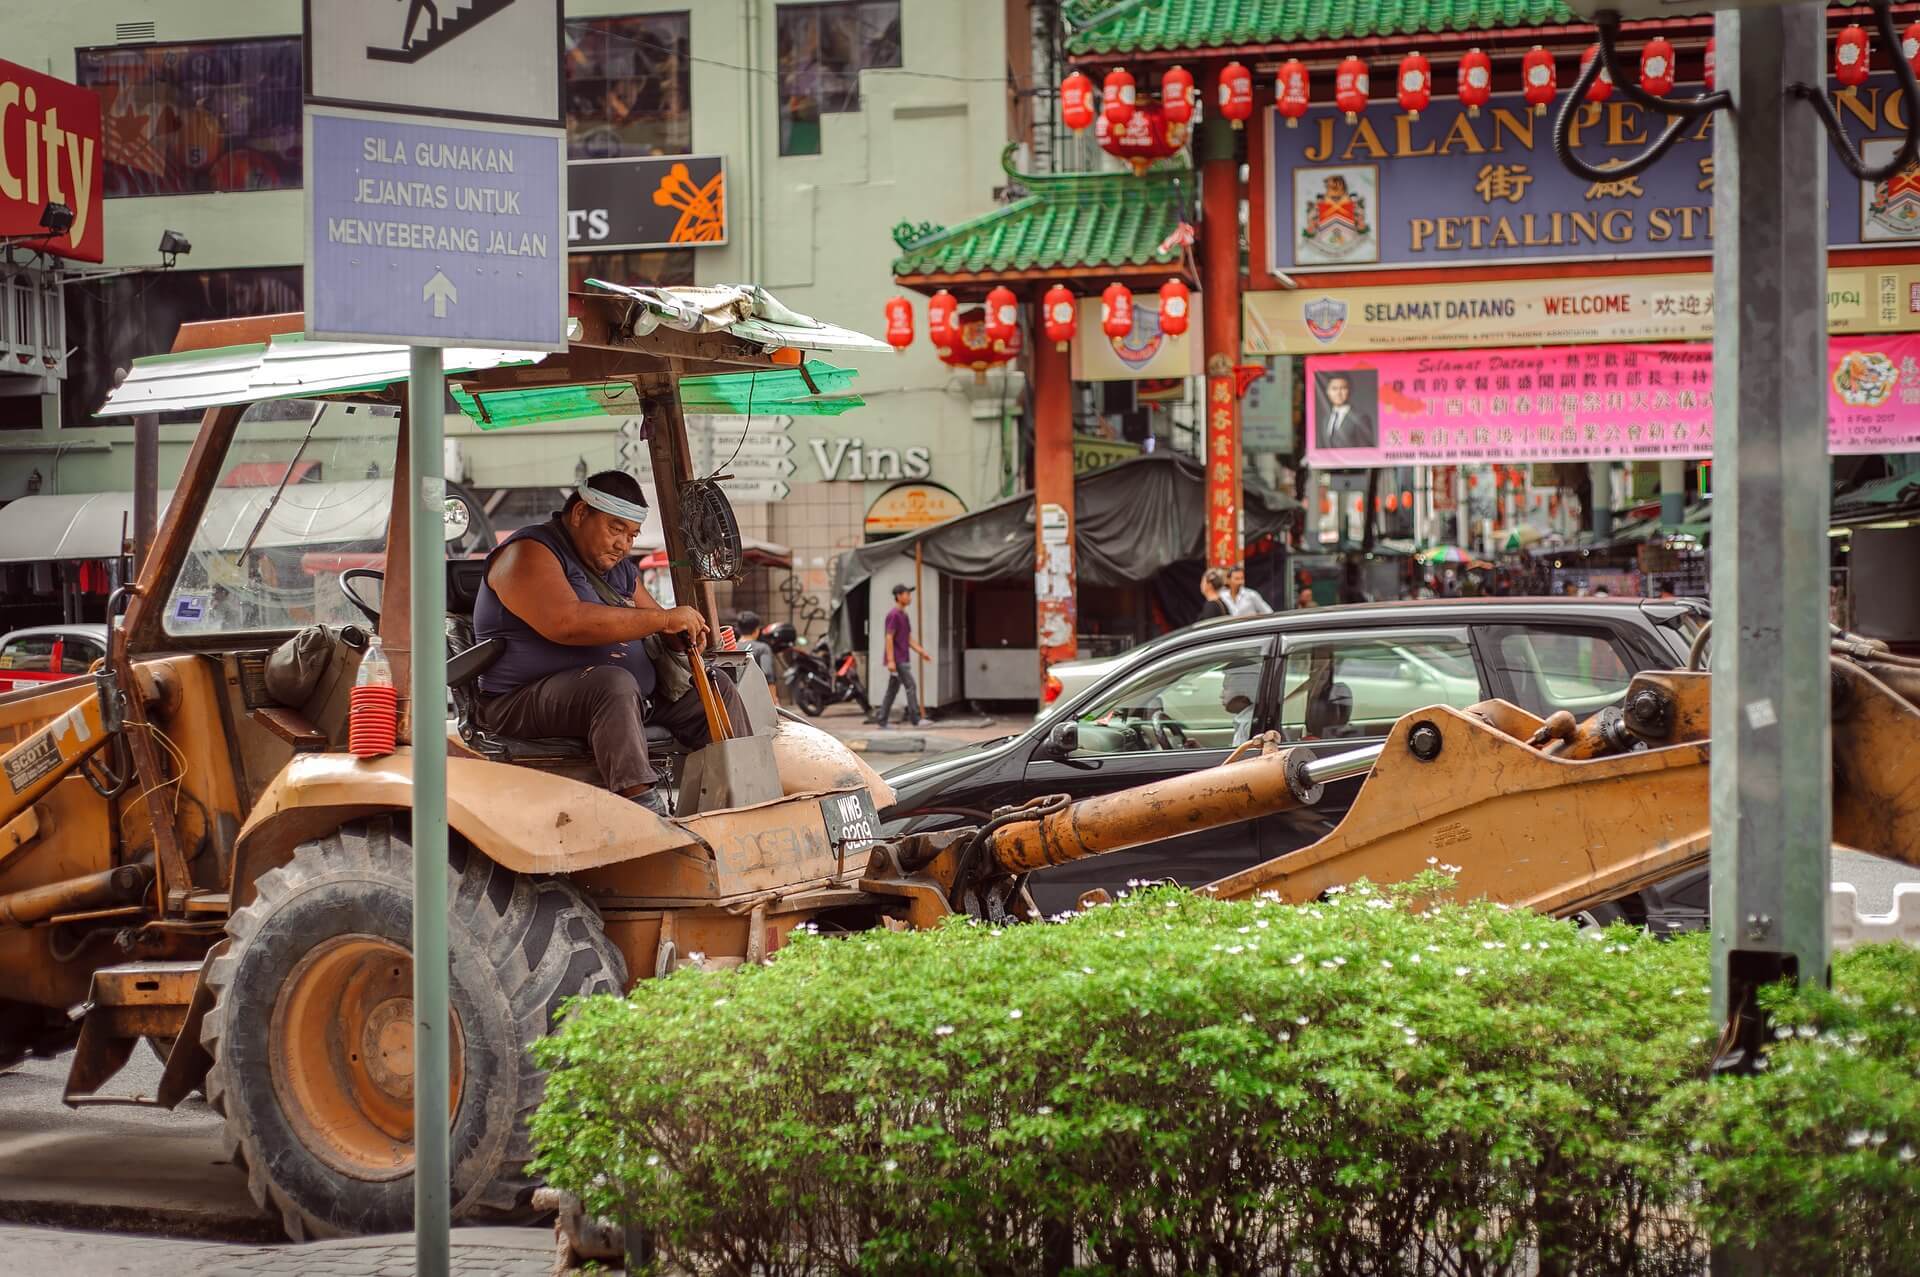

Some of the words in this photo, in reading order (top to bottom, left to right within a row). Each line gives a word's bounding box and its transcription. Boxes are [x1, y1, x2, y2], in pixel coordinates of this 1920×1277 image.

[1303, 107, 1535, 161] JALAN
[0, 81, 94, 248] City
[363, 136, 408, 166] SILA
[415, 142, 514, 173] GUNAKAN
[354, 178, 448, 210] JEJANTAS
[455, 186, 521, 216] UNTUK
[328, 217, 481, 253] MENYEBERANG
[486, 229, 548, 258] JALAN
[1410, 207, 1633, 252] PETALING
[1365, 301, 1442, 323] SELAMAT
[1446, 298, 1515, 320] DATANG
[1544, 294, 1631, 316] WELCOME
[1417, 357, 1481, 373] Selamat
[808, 437, 931, 481] Vins
[11, 741, 50, 773] SCOTT
[837, 794, 863, 823] WWB
